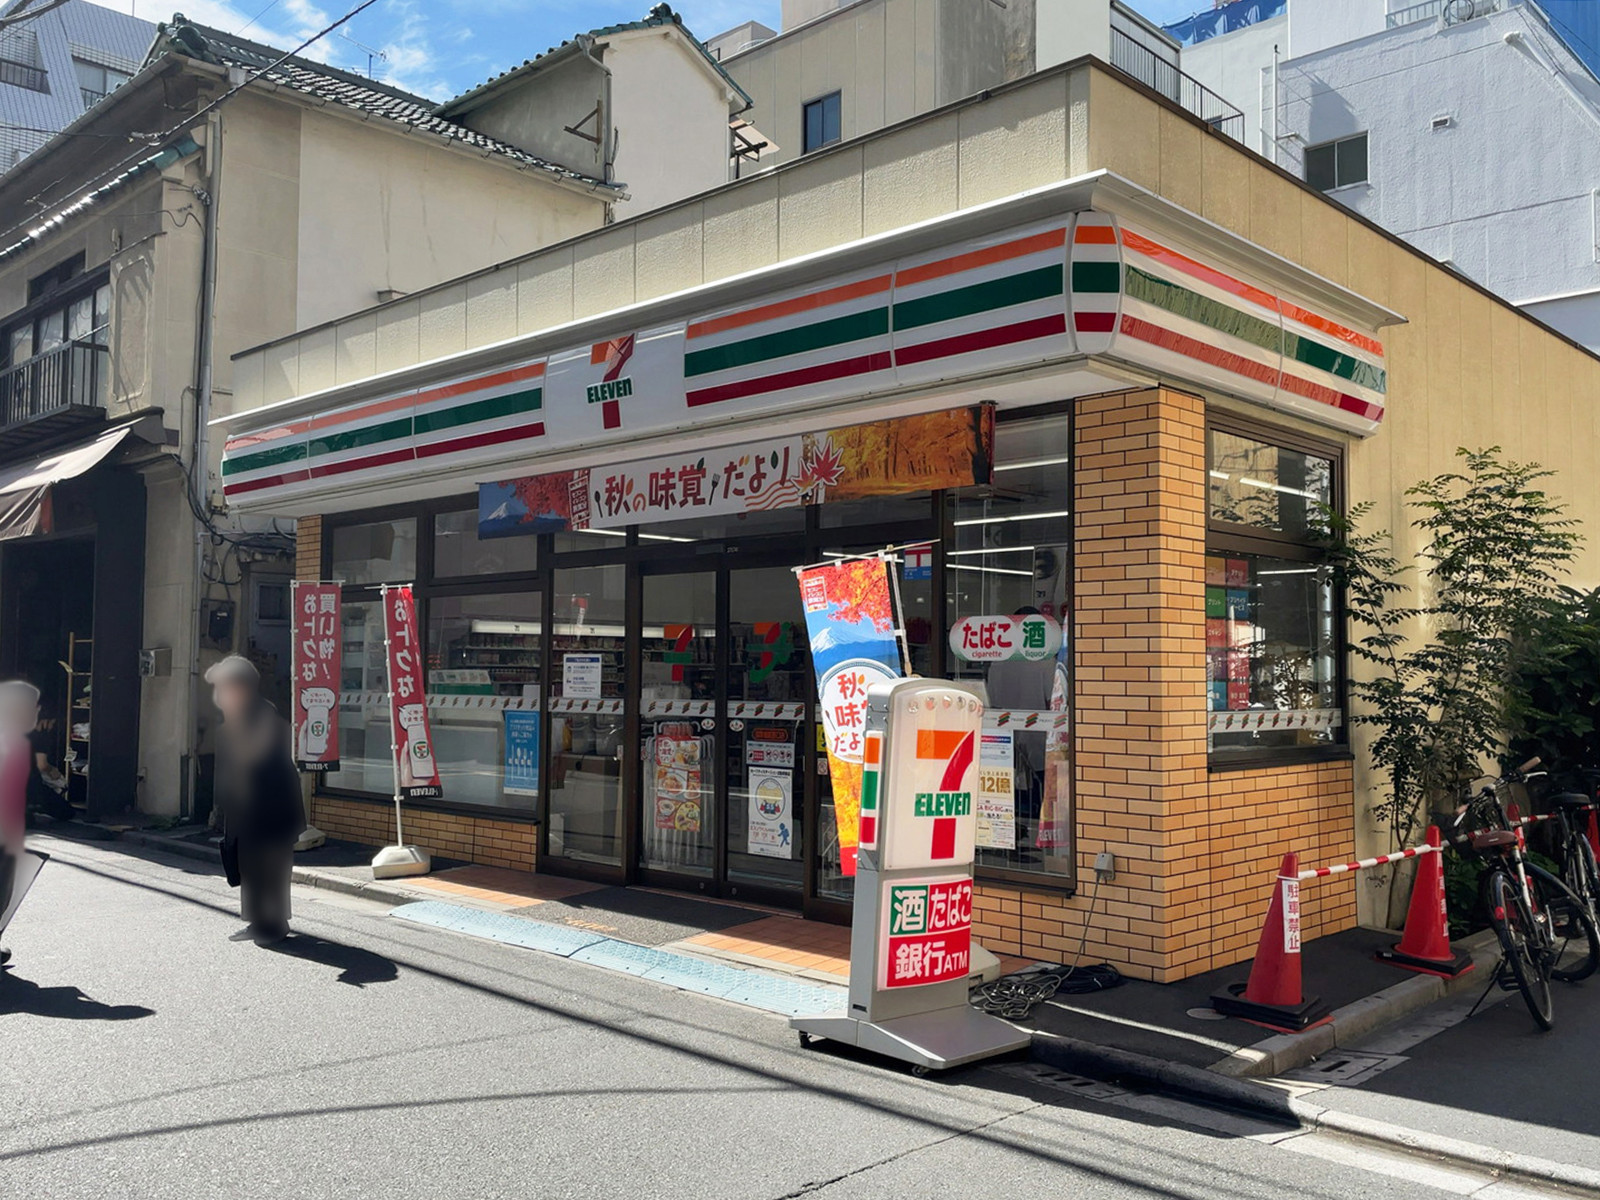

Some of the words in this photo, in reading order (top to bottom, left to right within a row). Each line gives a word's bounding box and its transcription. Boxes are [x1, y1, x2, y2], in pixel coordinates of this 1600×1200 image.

[587, 377, 633, 403] ELEVEN
[590, 332, 635, 430] 7
[962, 621, 1013, 650] たばこ
[1022, 620, 1046, 649] 酒
[972, 650, 1003, 660] cigarette
[834, 702, 868, 729] 味
[914, 791, 972, 817] ELEVEN
[916, 729, 975, 860] 7
[892, 889, 927, 934] 酒
[928, 885, 972, 930] たばこ
[1287, 883, 1300, 951] 駐車禁止
[895, 941, 969, 980] 銀行ATM
